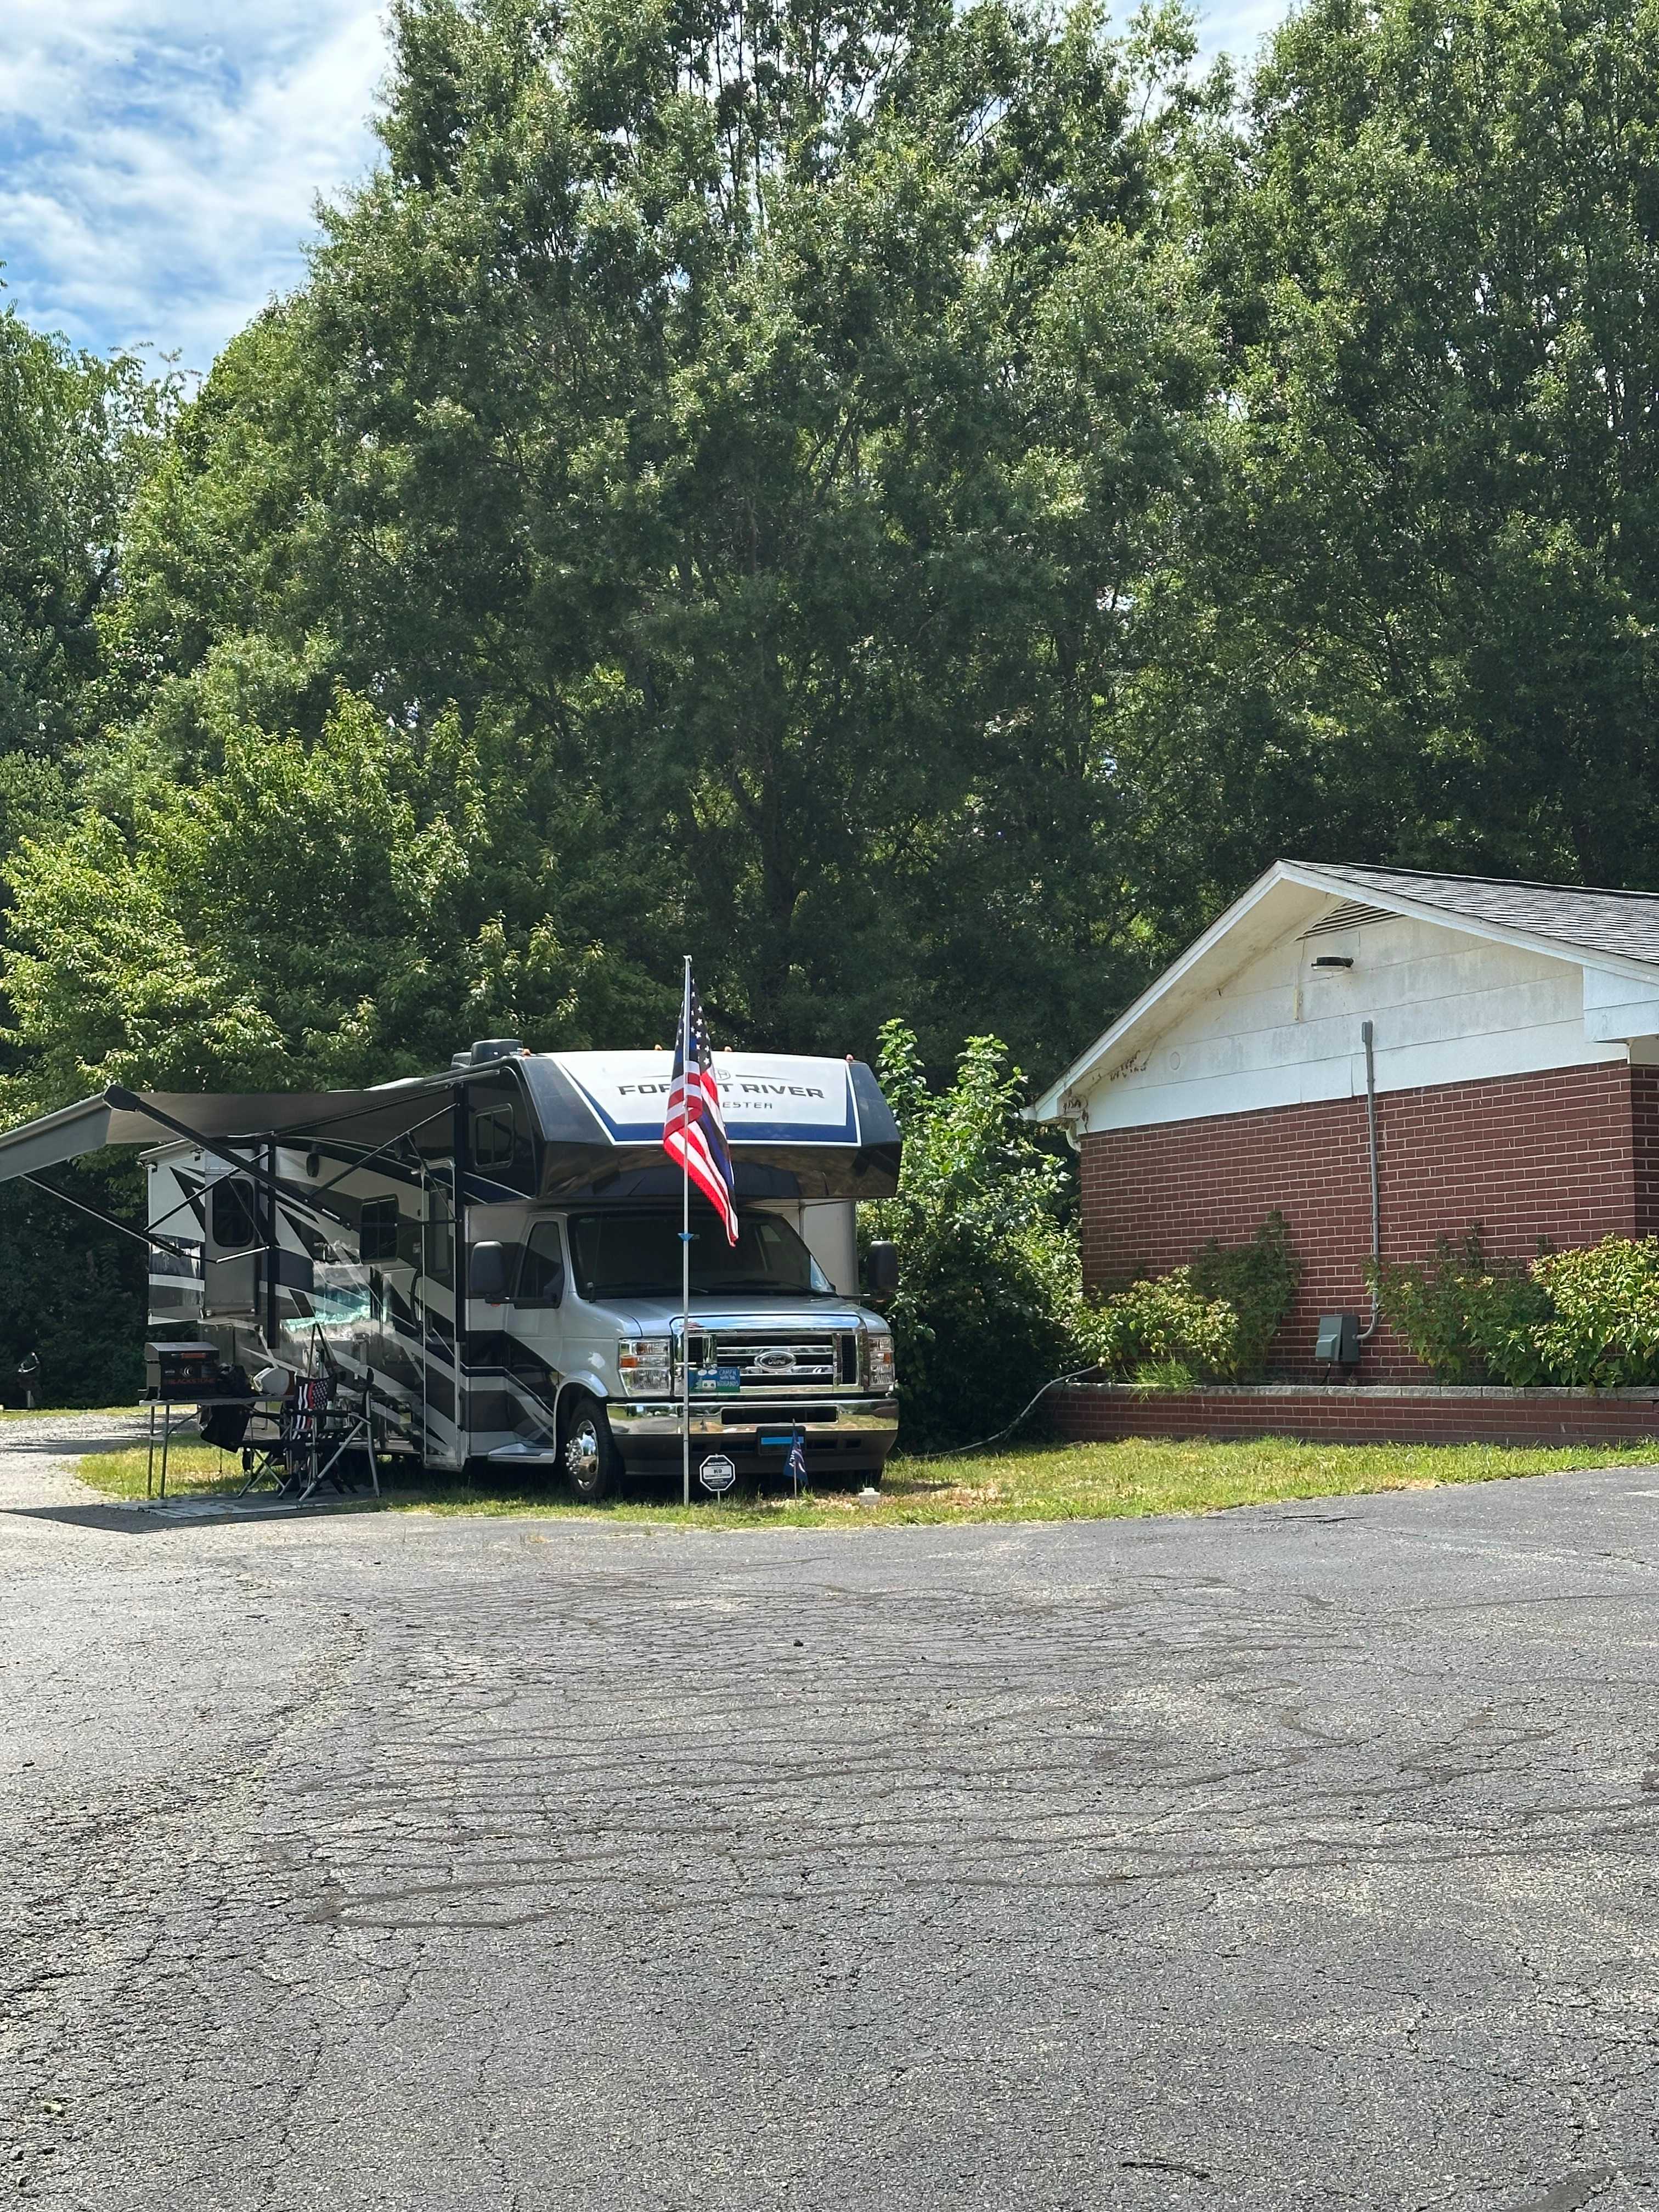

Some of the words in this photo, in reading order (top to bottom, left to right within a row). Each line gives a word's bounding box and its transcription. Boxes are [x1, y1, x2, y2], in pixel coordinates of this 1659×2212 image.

[617, 1083, 733, 1096] FORT
[739, 1083, 825, 1099] RIVER
[768, 1356, 786, 1365] Ford
